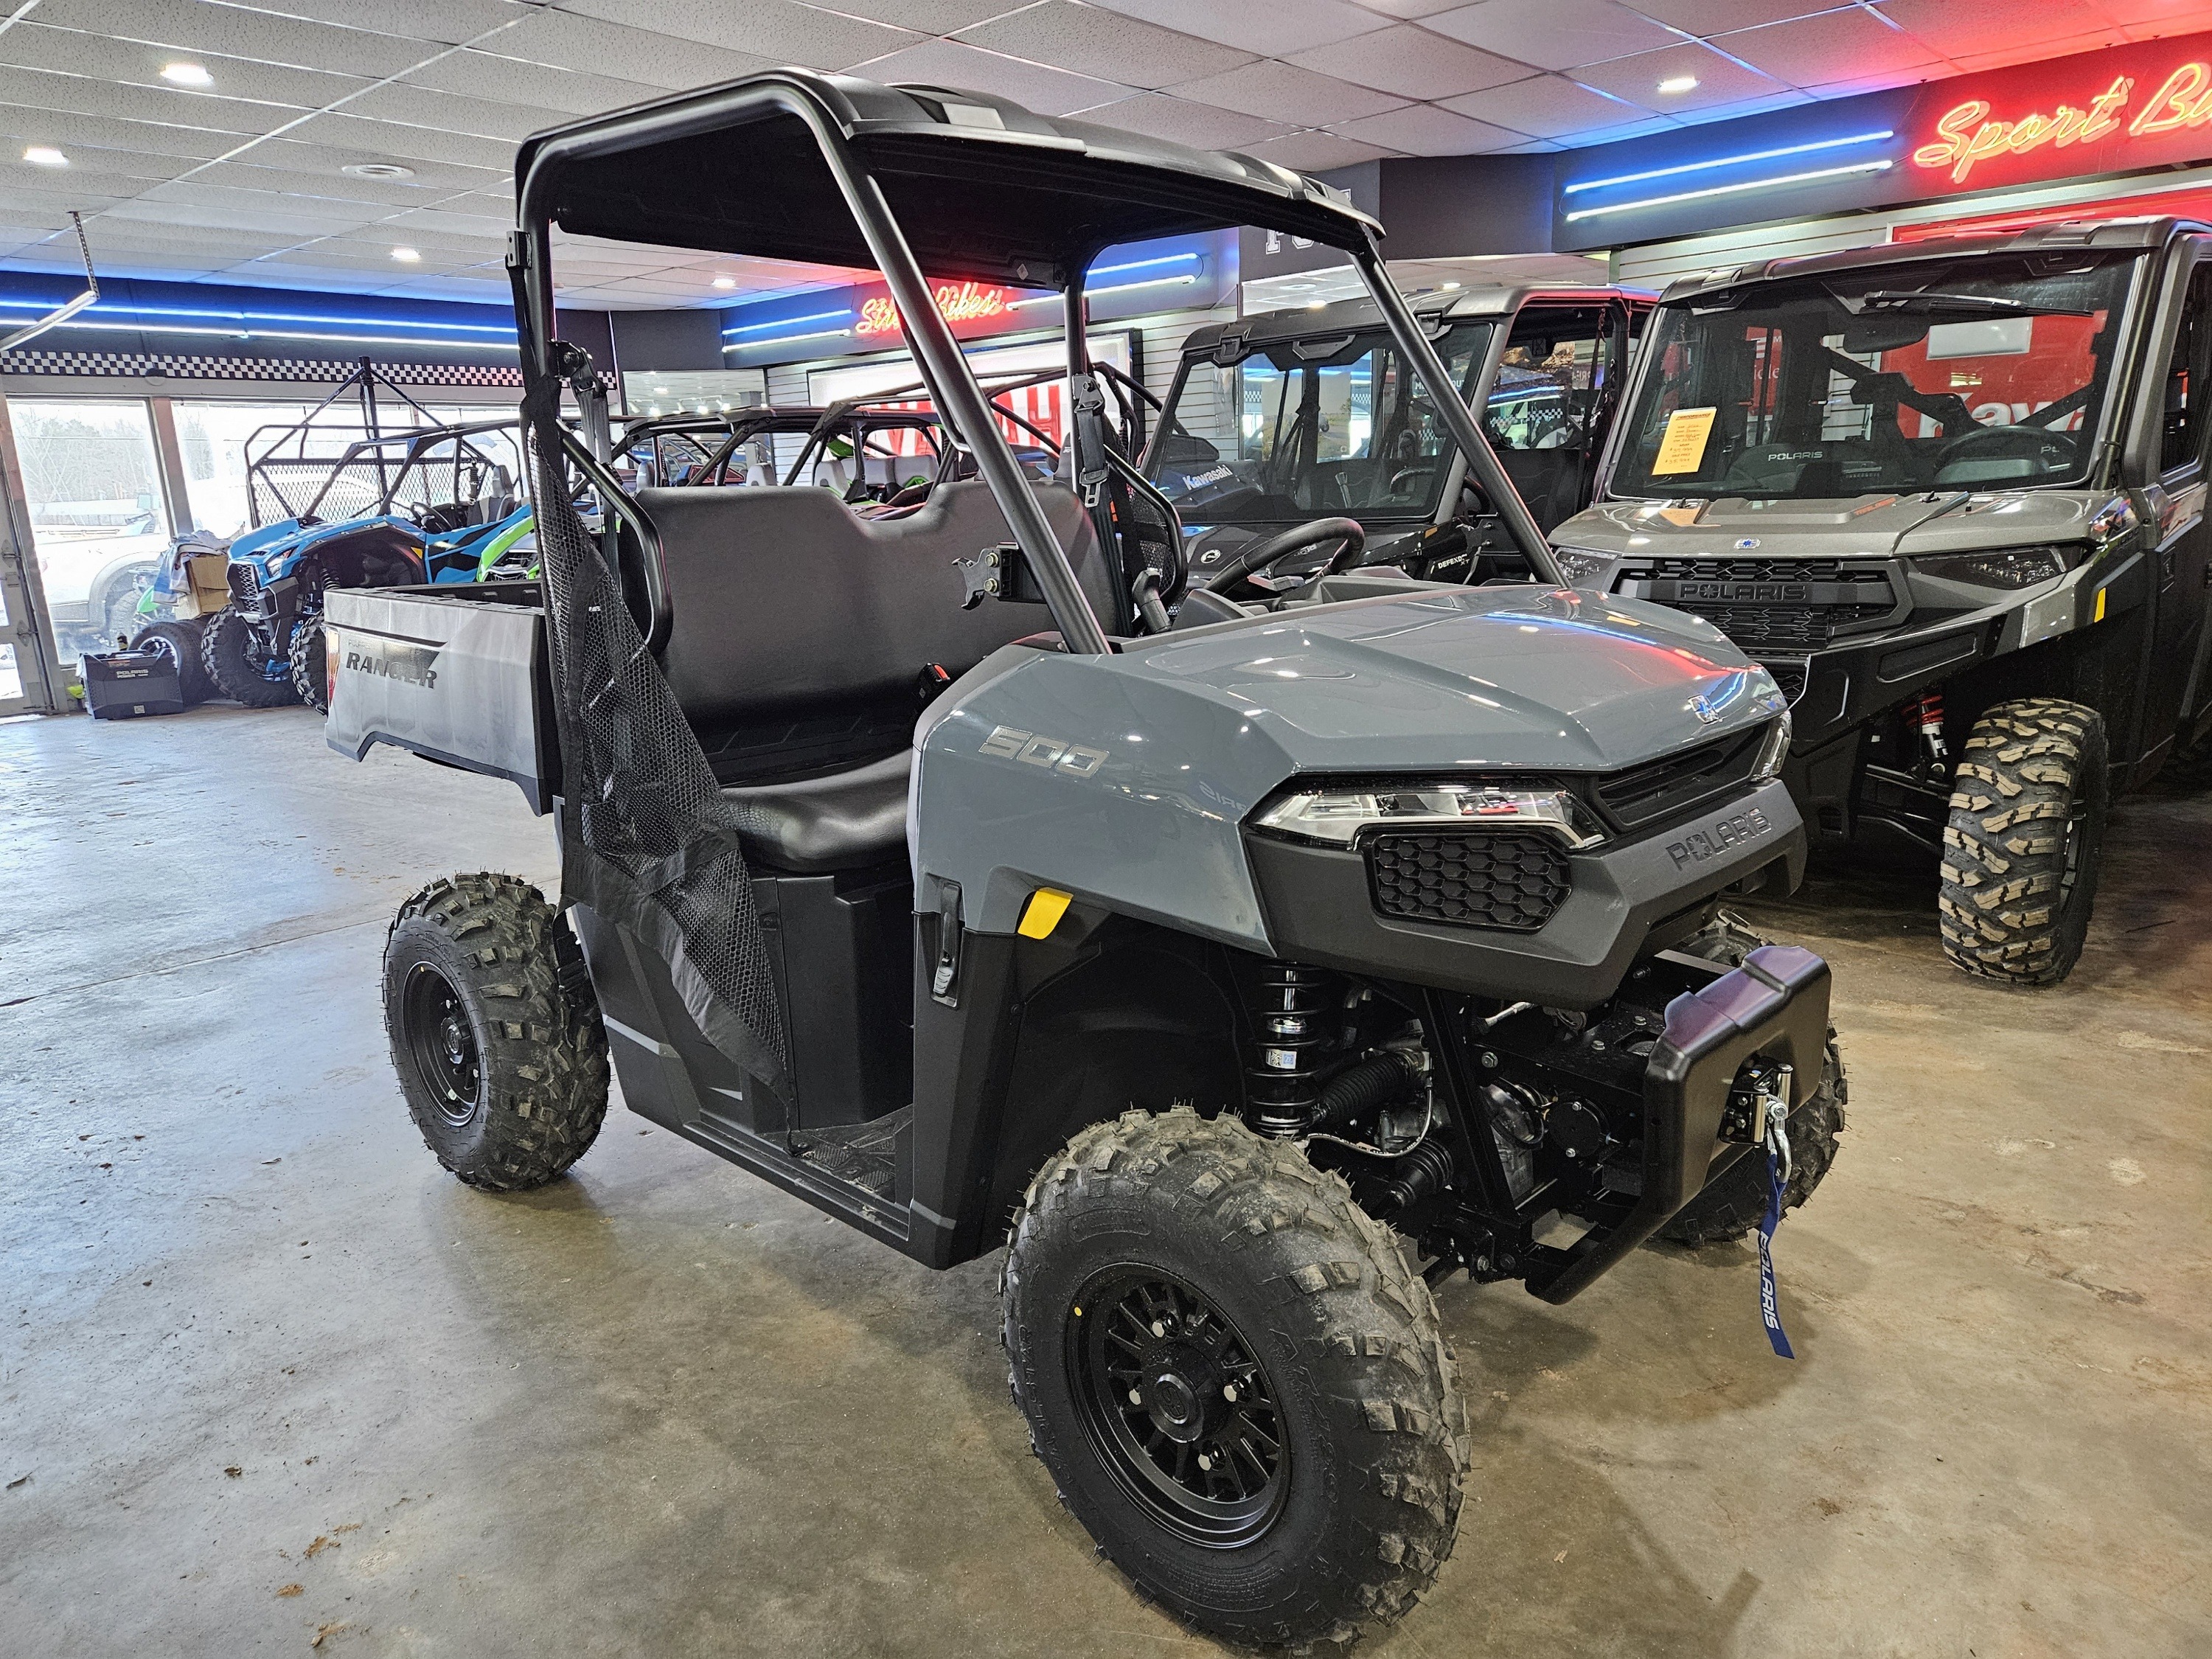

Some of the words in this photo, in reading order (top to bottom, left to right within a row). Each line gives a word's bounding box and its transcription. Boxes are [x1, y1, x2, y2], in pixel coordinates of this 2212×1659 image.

[1915, 74, 2133, 183] Sport
[1183, 465, 1233, 490] Kawasaki
[1768, 451, 1823, 461] POLARIS
[1680, 583, 1806, 601] POLARIS
[346, 652, 437, 689] RANGER
[978, 725, 1110, 779] 500
[1666, 807, 1772, 872] POLARIS
[1760, 1231, 1780, 1330] POLARIS
